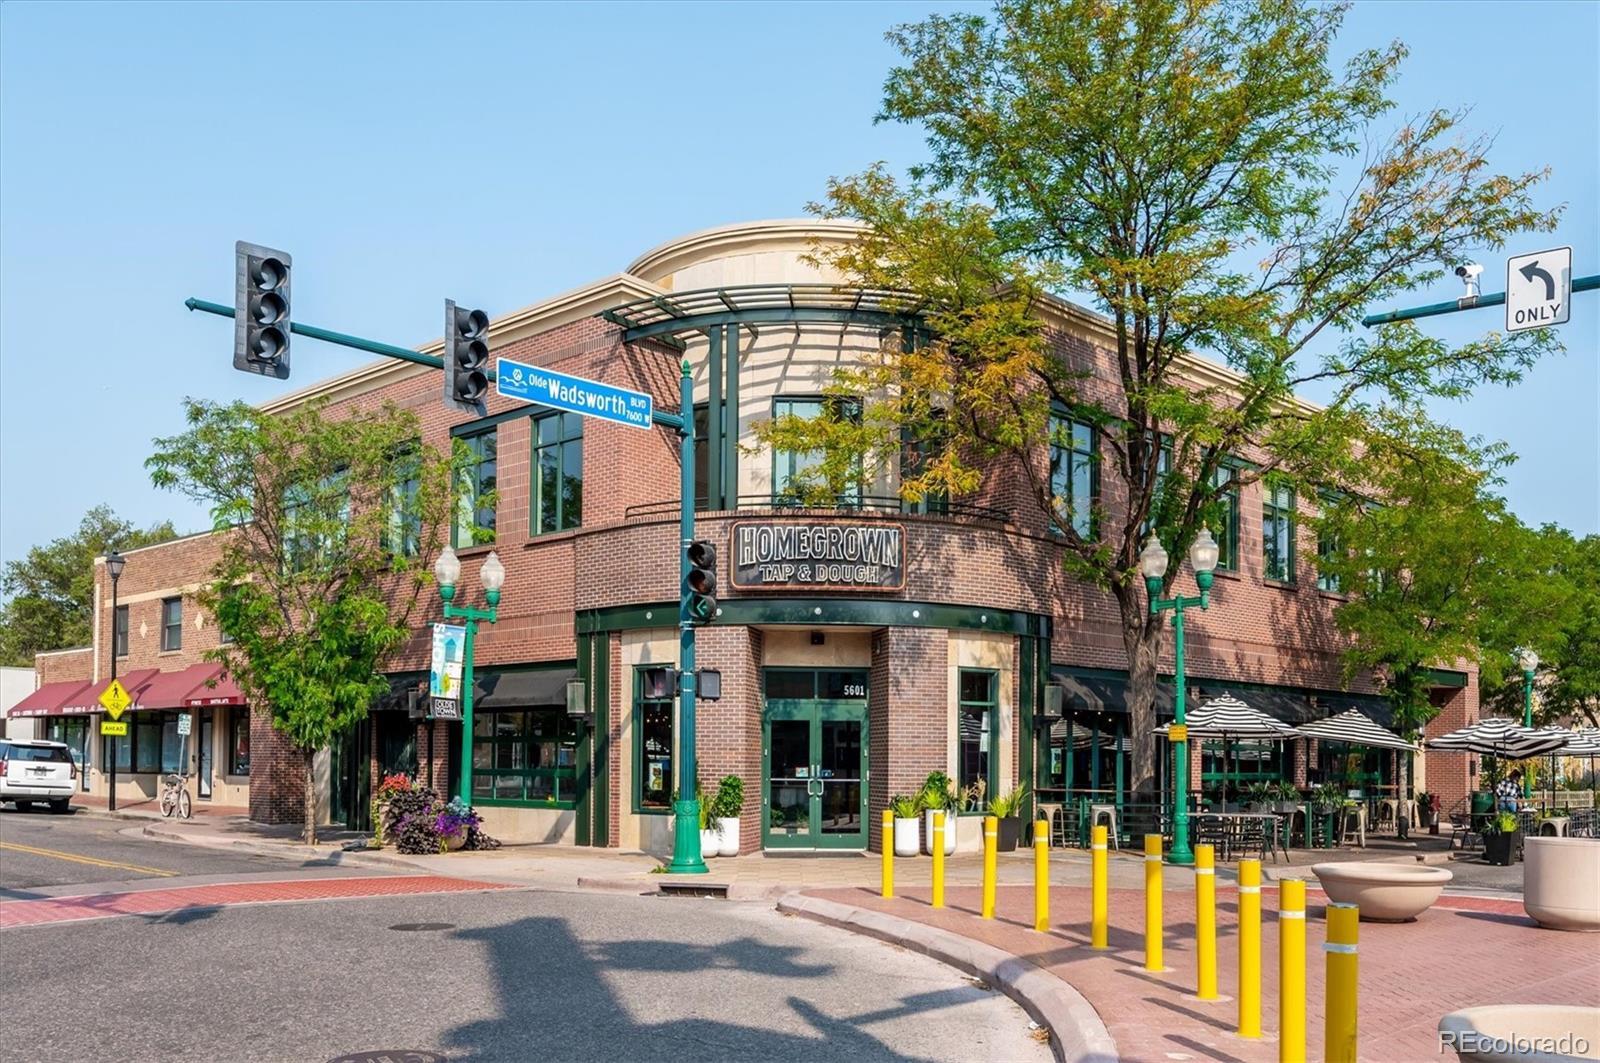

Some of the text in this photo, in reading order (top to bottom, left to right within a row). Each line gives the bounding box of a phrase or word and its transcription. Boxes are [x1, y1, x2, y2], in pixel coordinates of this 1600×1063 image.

[1515, 303, 1561, 324] ONLY
[528, 374, 548, 389] Olde
[548, 378, 627, 417] Wadsworth
[630, 397, 647, 410] BLVD
[626, 410, 643, 422] 7600
[739, 526, 899, 568] HOMEGROWN
[759, 564, 879, 583] TAP & DOUGH
[843, 684, 865, 696] 5601
[436, 707, 457, 718] TOWN
